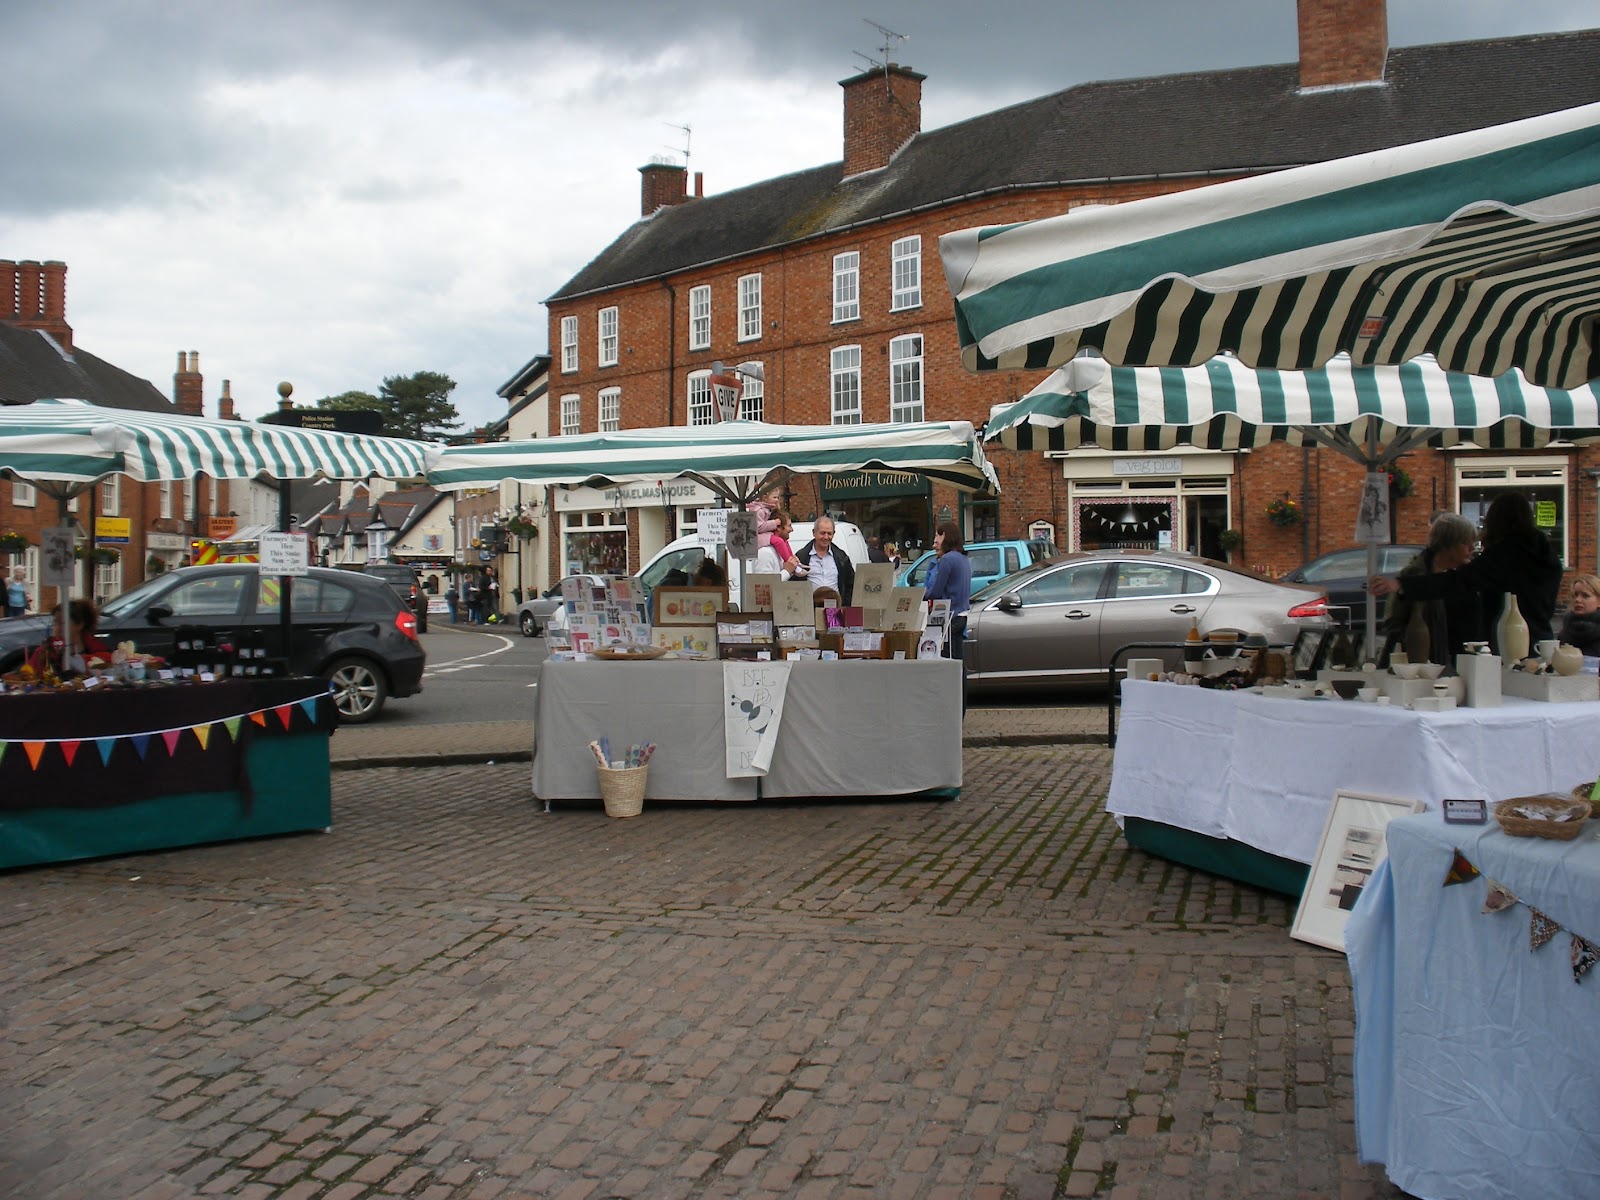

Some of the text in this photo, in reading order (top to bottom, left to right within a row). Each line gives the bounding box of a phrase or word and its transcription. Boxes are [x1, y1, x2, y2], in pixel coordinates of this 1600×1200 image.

[718, 388, 735, 408] GIVE
[1127, 460, 1151, 473] veg
[1153, 458, 1179, 473] plot
[825, 472, 871, 490] Bosworth
[562, 493, 569, 503] 4
[663, 485, 696, 498] HOUSE
[742, 668, 776, 687] BEE
